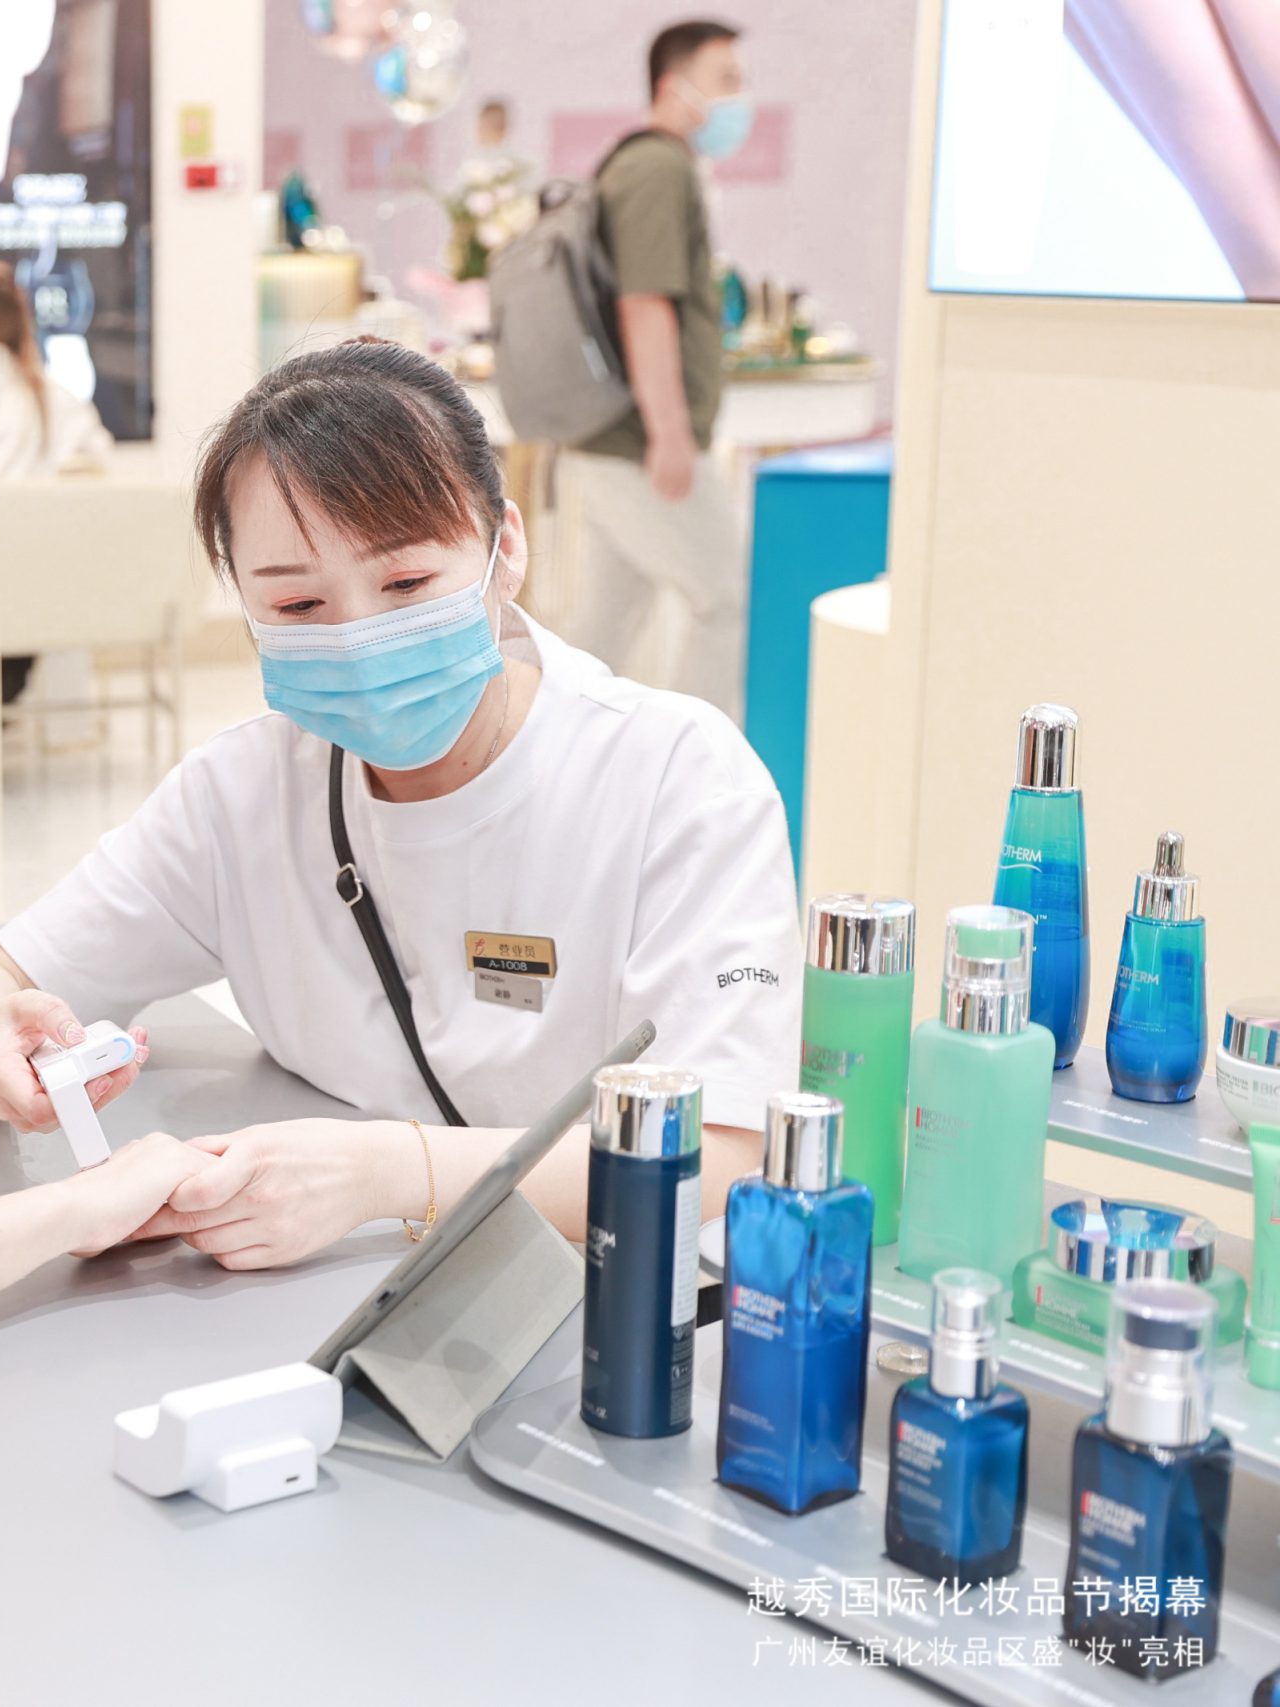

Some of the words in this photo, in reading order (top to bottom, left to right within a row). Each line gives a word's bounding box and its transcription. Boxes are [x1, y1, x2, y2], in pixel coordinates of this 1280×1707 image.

[1001, 844, 1042, 863] OTHERM
[717, 968, 779, 989] BIOTHERM
[1119, 965, 1159, 986] OTHERM
